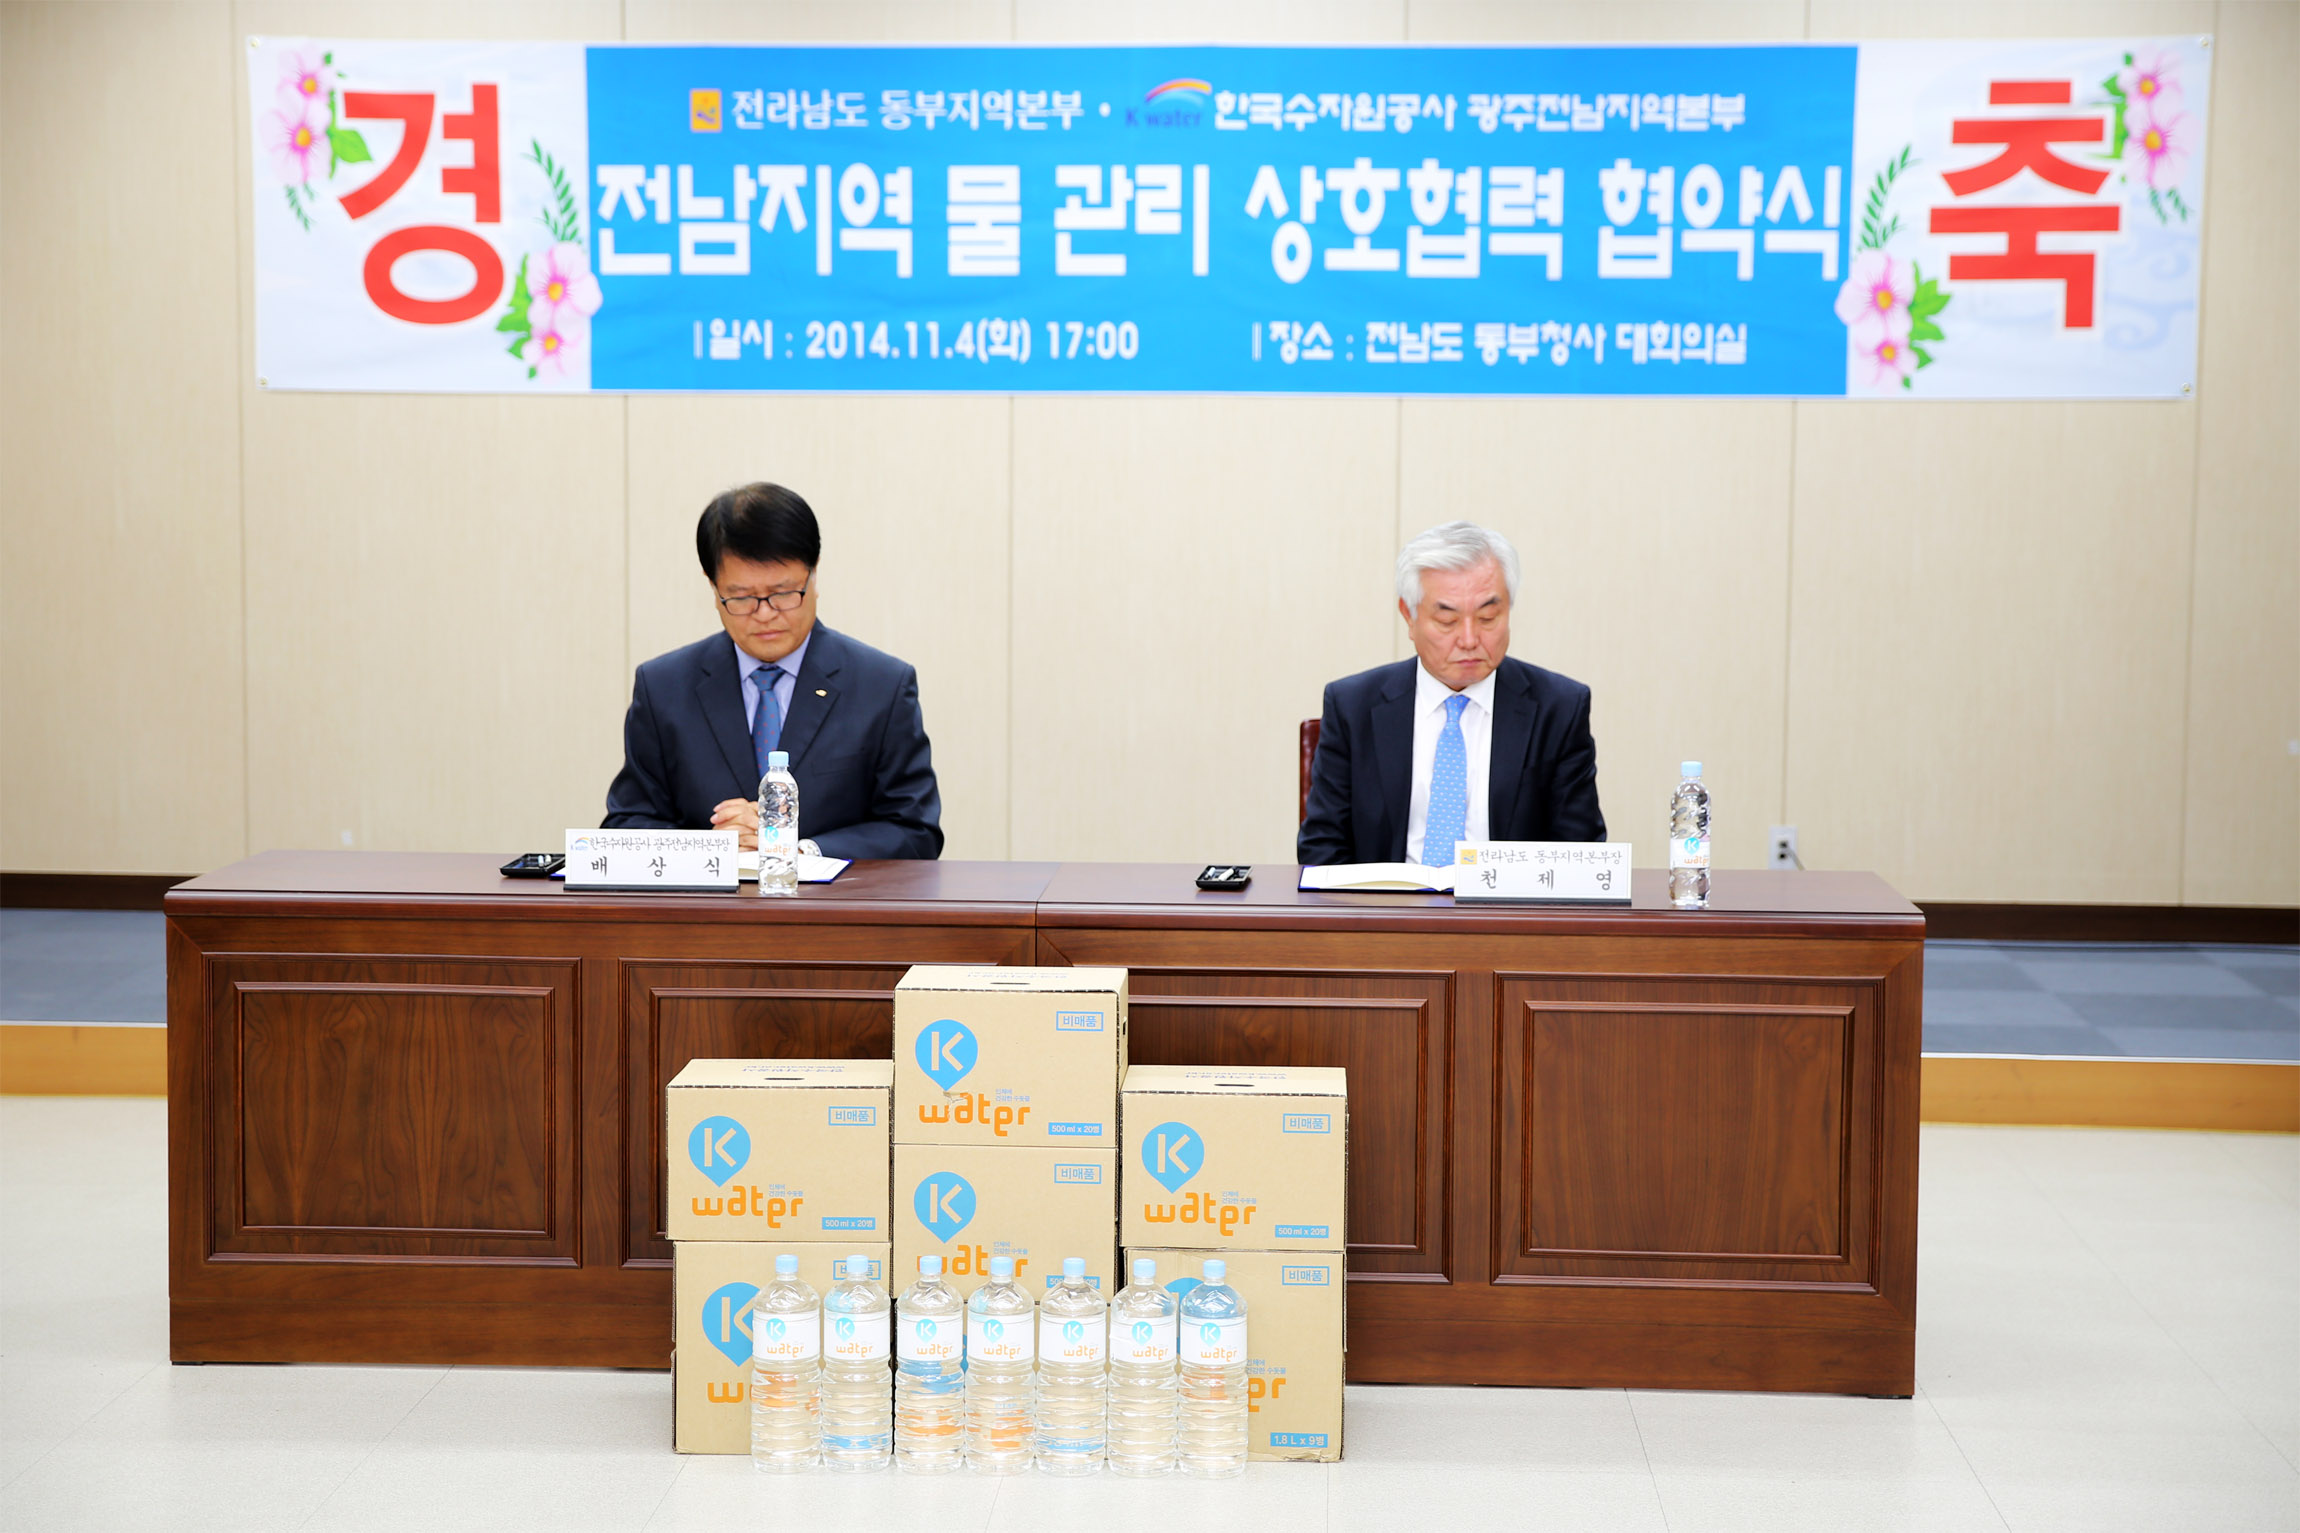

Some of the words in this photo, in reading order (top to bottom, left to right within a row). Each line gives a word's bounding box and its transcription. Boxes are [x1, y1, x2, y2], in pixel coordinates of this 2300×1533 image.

[732, 90, 868, 131] 전라남도
[880, 89, 1084, 131] 동부지역본부
[1214, 90, 1457, 133] 한국수자원공사
[1467, 91, 1746, 133] 광주전남지역본부
[338, 82, 505, 325] 경
[1928, 79, 2121, 329] 축
[596, 162, 913, 279] 전남지역
[946, 164, 1022, 277] 물
[1054, 163, 1210, 277] 관리
[1244, 157, 1564, 284] 상호협력
[1598, 158, 1842, 281] 협약식
[709, 319, 774, 360] 일시
[805, 317, 1031, 363] 2014.11.4(화)
[1046, 320, 1140, 360] 17:00
[1269, 321, 1334, 365] 장소
[1365, 321, 1464, 363] 전남도
[1474, 321, 1607, 366] 동부청사
[1616, 322, 1748, 365] 대회의실
[589, 836, 650, 851] 한국수자원공사
[1479, 849, 1529, 863] 전라남도
[1534, 850, 1623, 865] 동부지역본부장
[1062, 1015, 1098, 1028] 비매품
[931, 1031, 964, 1072] K
[835, 1110, 870, 1122] 비매품
[918, 1092, 1031, 1137] water
[1289, 1117, 1324, 1130] 비매품
[703, 1127, 737, 1168] K
[1157, 1133, 1191, 1174] K
[1061, 1168, 1095, 1180] 비매품
[691, 1185, 804, 1229] water
[929, 1183, 963, 1224] K
[1144, 1192, 1257, 1237] water
[917, 1244, 1029, 1278] atr
[1288, 1270, 1323, 1282] 비매품
[766, 1343, 805, 1358] water
[835, 1342, 874, 1357] water
[916, 1344, 953, 1359] water
[983, 1344, 1022, 1359] water
[1063, 1345, 1099, 1359] water
[1132, 1346, 1169, 1360] water
[1200, 1347, 1238, 1362] water
[1274, 1434, 1288, 1445] 1.8
